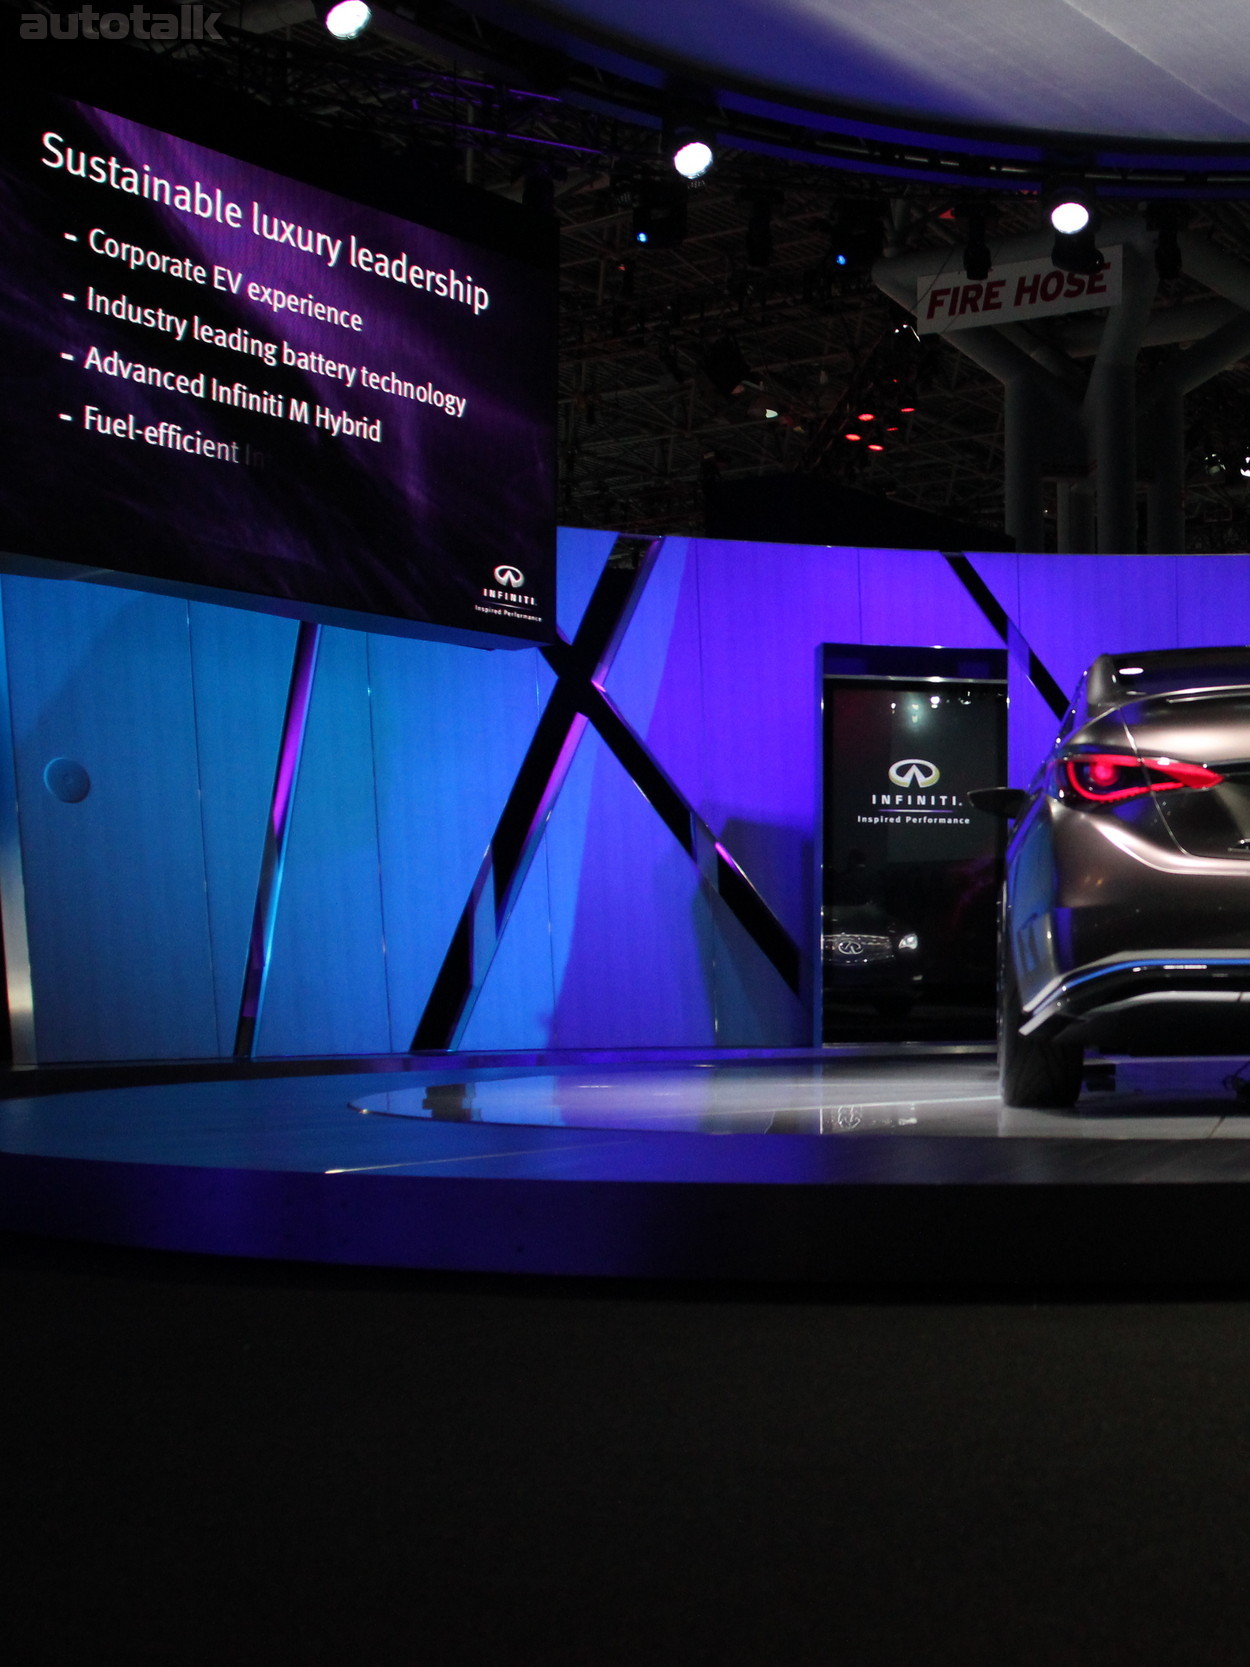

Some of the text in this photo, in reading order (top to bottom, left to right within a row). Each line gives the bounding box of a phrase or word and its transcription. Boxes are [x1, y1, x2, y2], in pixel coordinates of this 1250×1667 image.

[41, 131, 489, 315] Sustainable luxury leadership
[88, 228, 364, 332] Corporate EV experience
[926, 262, 1111, 319] FIRE HOSE
[83, 346, 382, 443] Advanced Infiniti M Hybrid
[87, 286, 467, 418] Industry leading battery technology
[83, 404, 240, 464] Fuel-efficient
[857, 815, 971, 825] Inspired Performance
